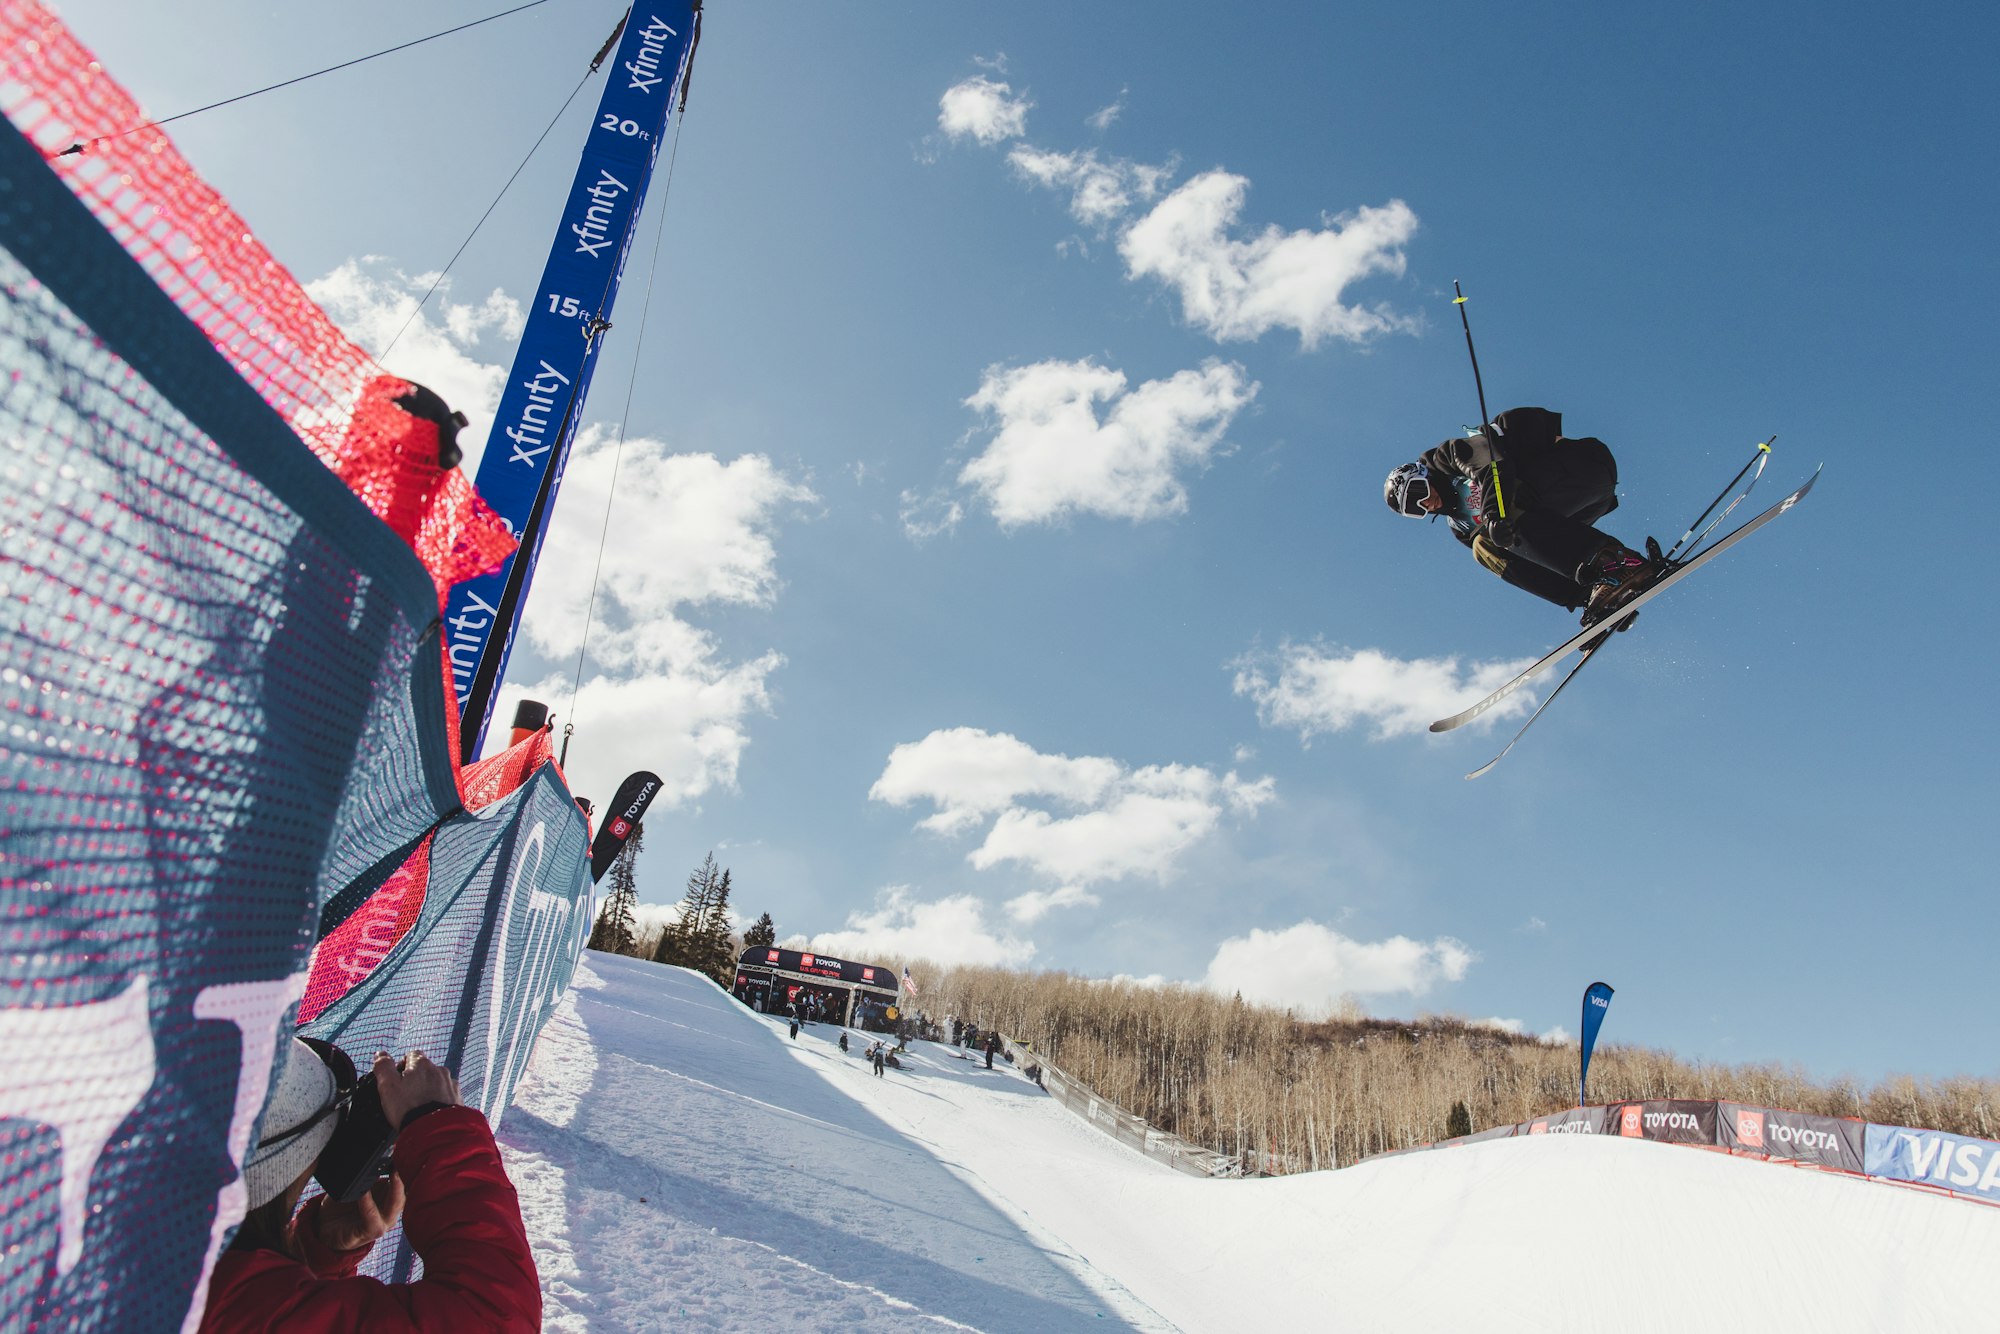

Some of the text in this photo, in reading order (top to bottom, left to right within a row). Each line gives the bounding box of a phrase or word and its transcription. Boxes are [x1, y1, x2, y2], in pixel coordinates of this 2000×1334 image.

[625, 15, 678, 95] xfinity
[572, 169, 628, 259] xfinity
[506, 359, 570, 469] xfinity
[449, 589, 499, 705] inity
[623, 781, 656, 819] TOYOTA
[815, 958, 842, 970] TOYOTA
[748, 978, 770, 986] TOYOTA
[1591, 995, 1608, 1009] VISA
[1644, 1113, 1700, 1130] TOYOTA
[1768, 1124, 1840, 1152] TOYOTA
